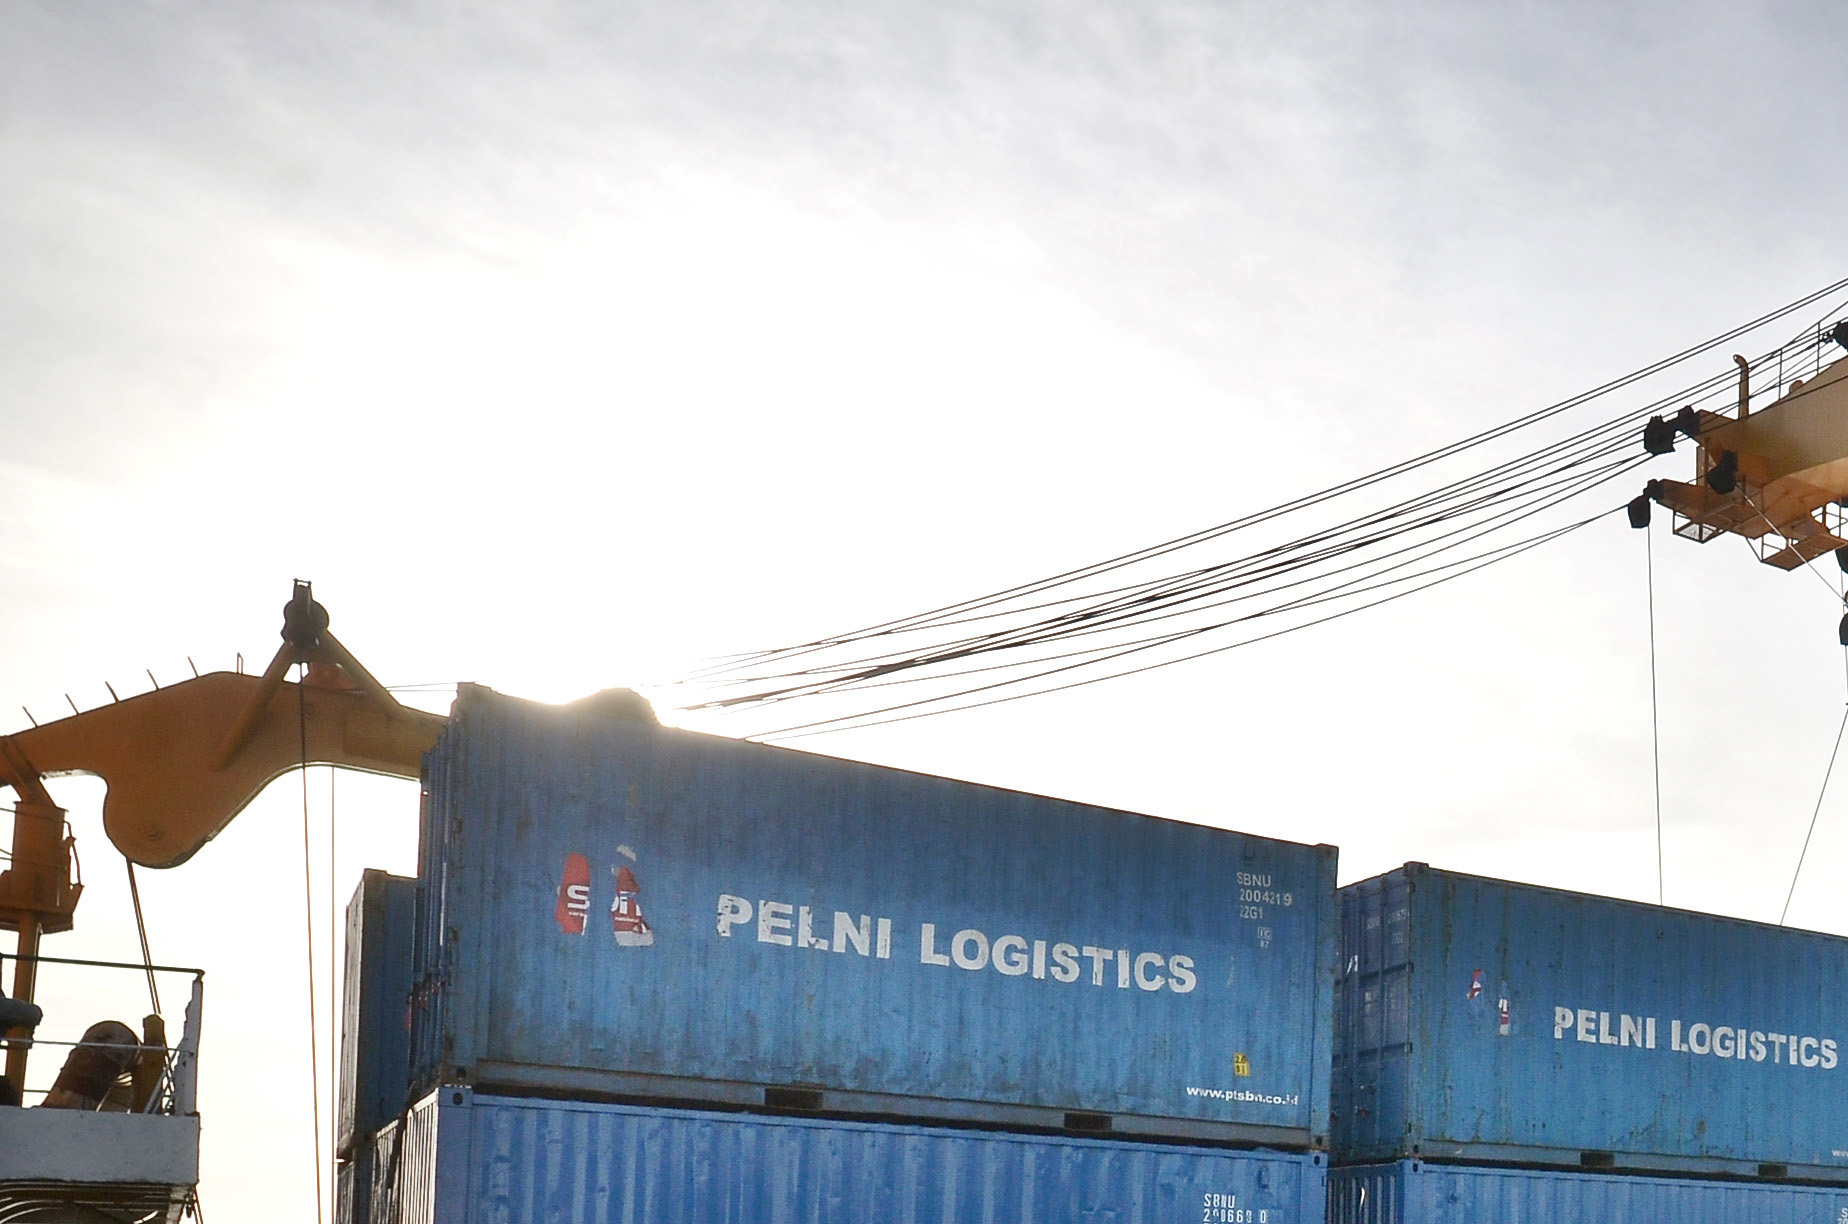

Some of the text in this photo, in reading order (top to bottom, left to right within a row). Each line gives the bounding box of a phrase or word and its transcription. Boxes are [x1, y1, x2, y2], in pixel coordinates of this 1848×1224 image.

[1236, 871, 1271, 887] SBNU
[1240, 904, 1263, 919] 22G1
[716, 894, 892, 959] PELNI
[920, 923, 1198, 993] LOGISTICS
[1554, 1005, 1839, 1070] PELNI LOGISTICS
[1186, 1086, 1299, 1106] www.ptsbn.co.id
[1203, 1193, 1236, 1209] SBNU
